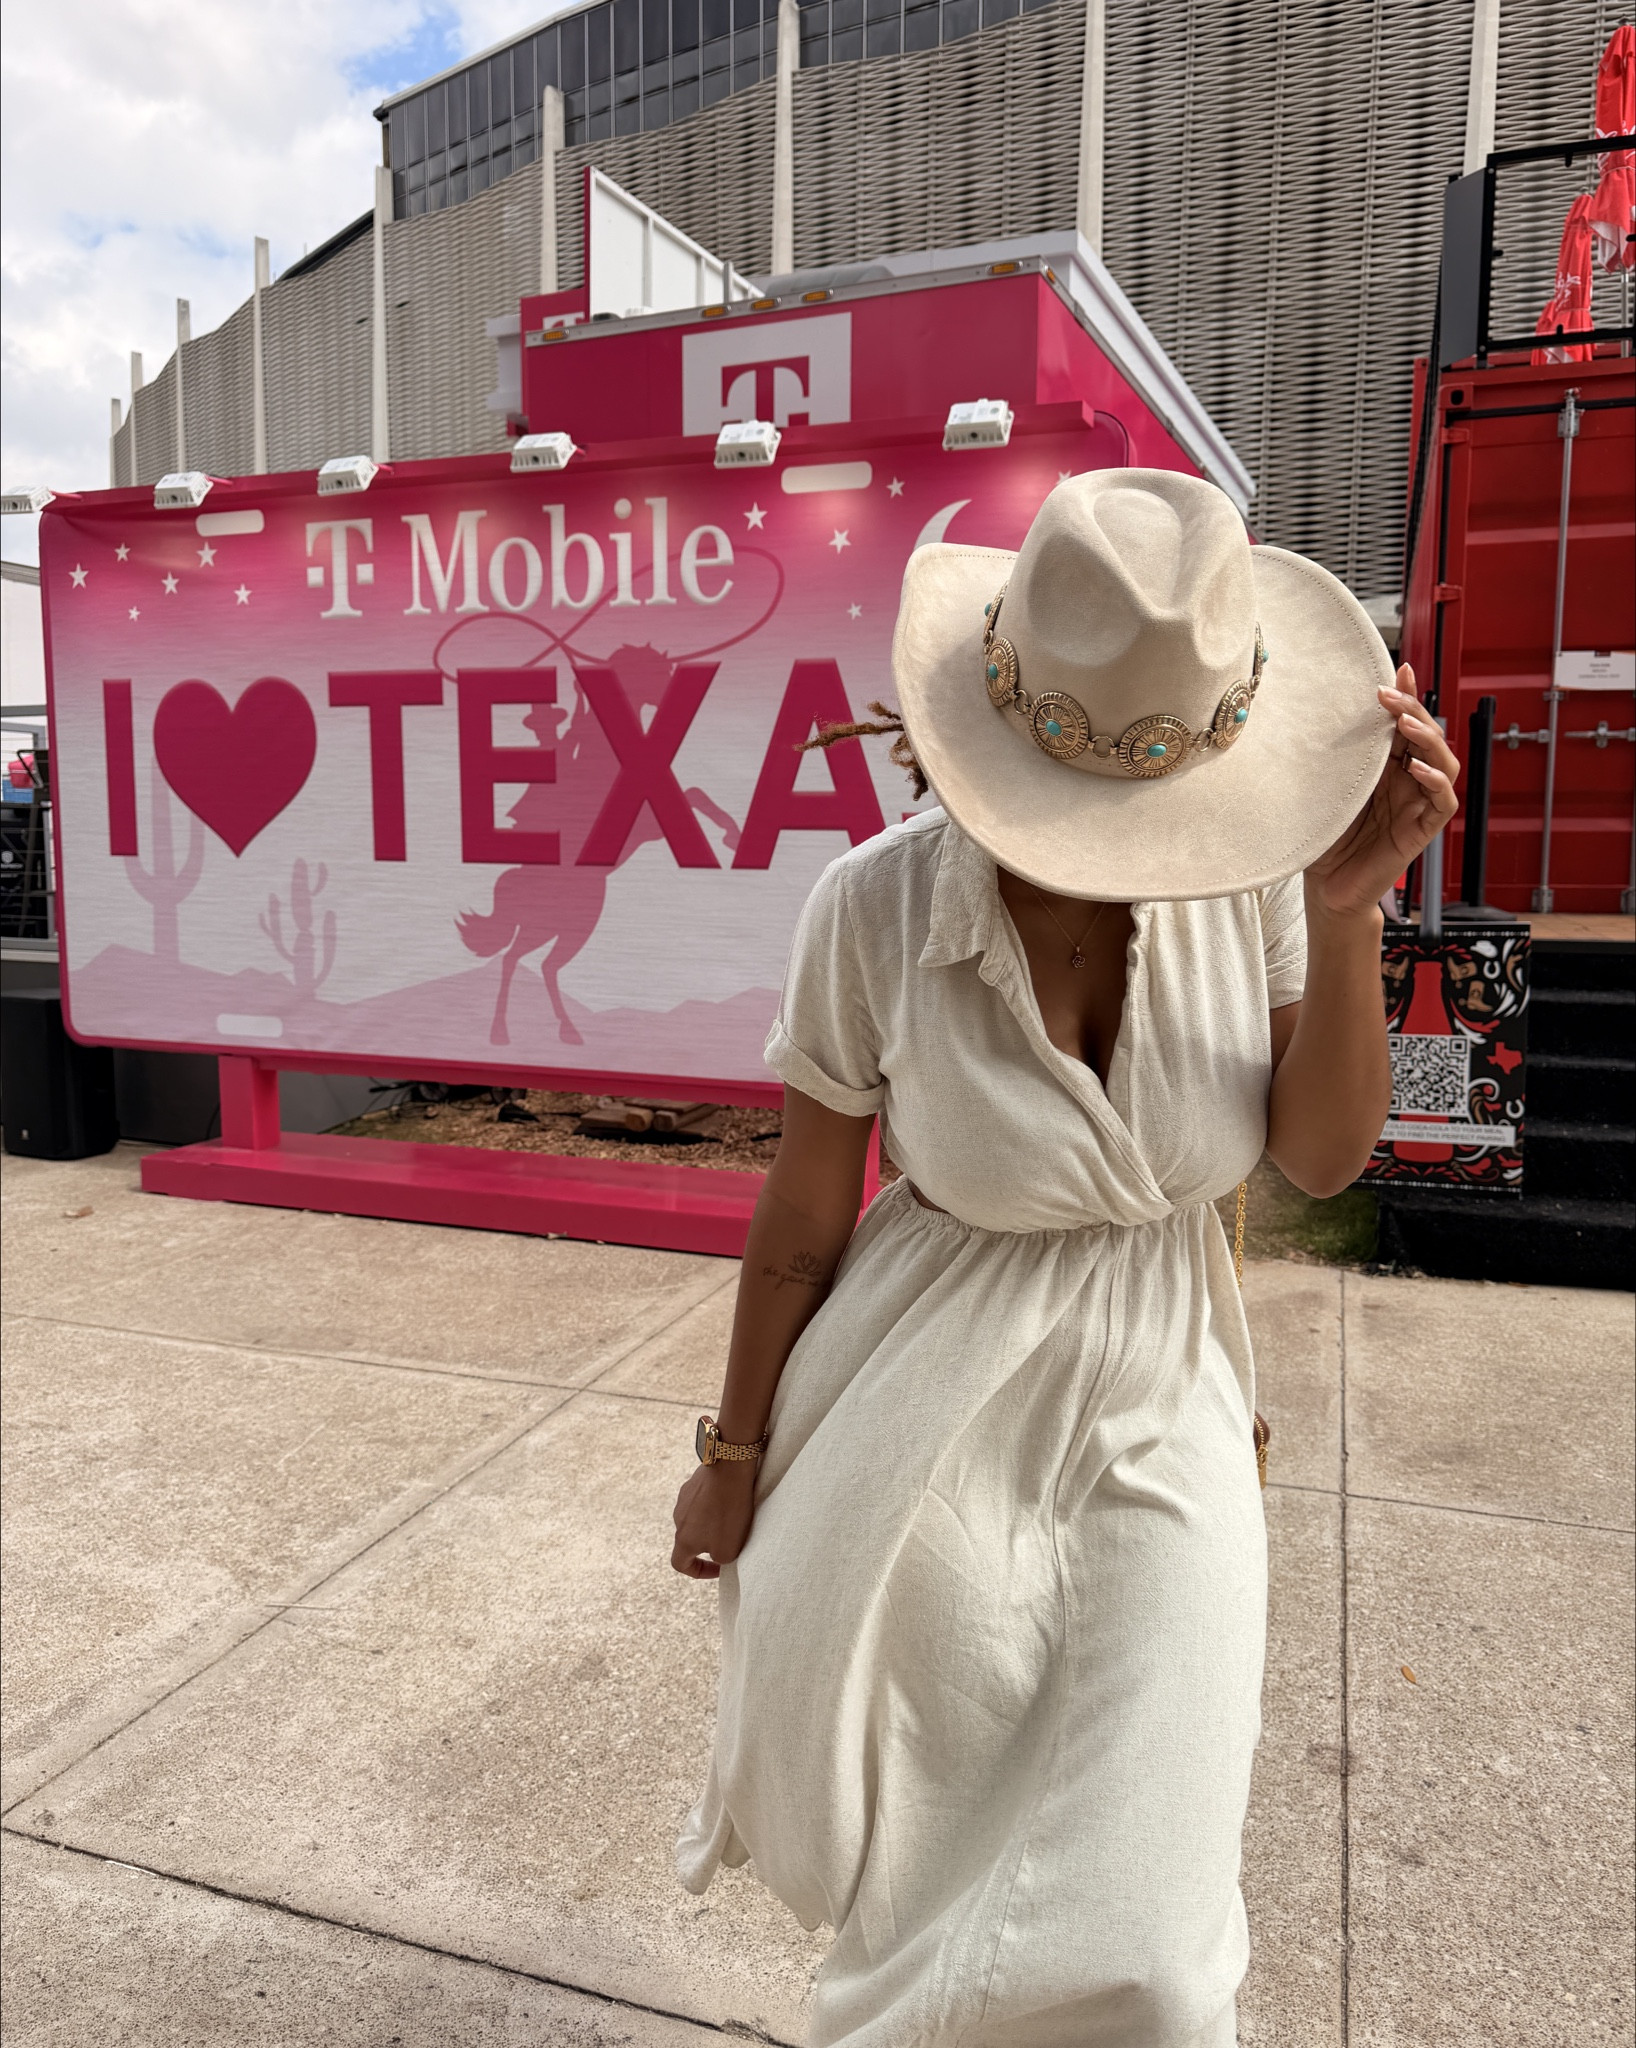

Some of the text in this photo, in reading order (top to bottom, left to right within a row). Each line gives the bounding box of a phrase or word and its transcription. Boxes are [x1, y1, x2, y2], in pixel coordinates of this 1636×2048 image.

[721, 355, 810, 428] T
[401, 496, 735, 616] Mobile
[103, 658, 922, 870] I TEXA
[1407, 1123, 1449, 1132] COCA-COLA
[1441, 1133, 1475, 1141] PERFECT
